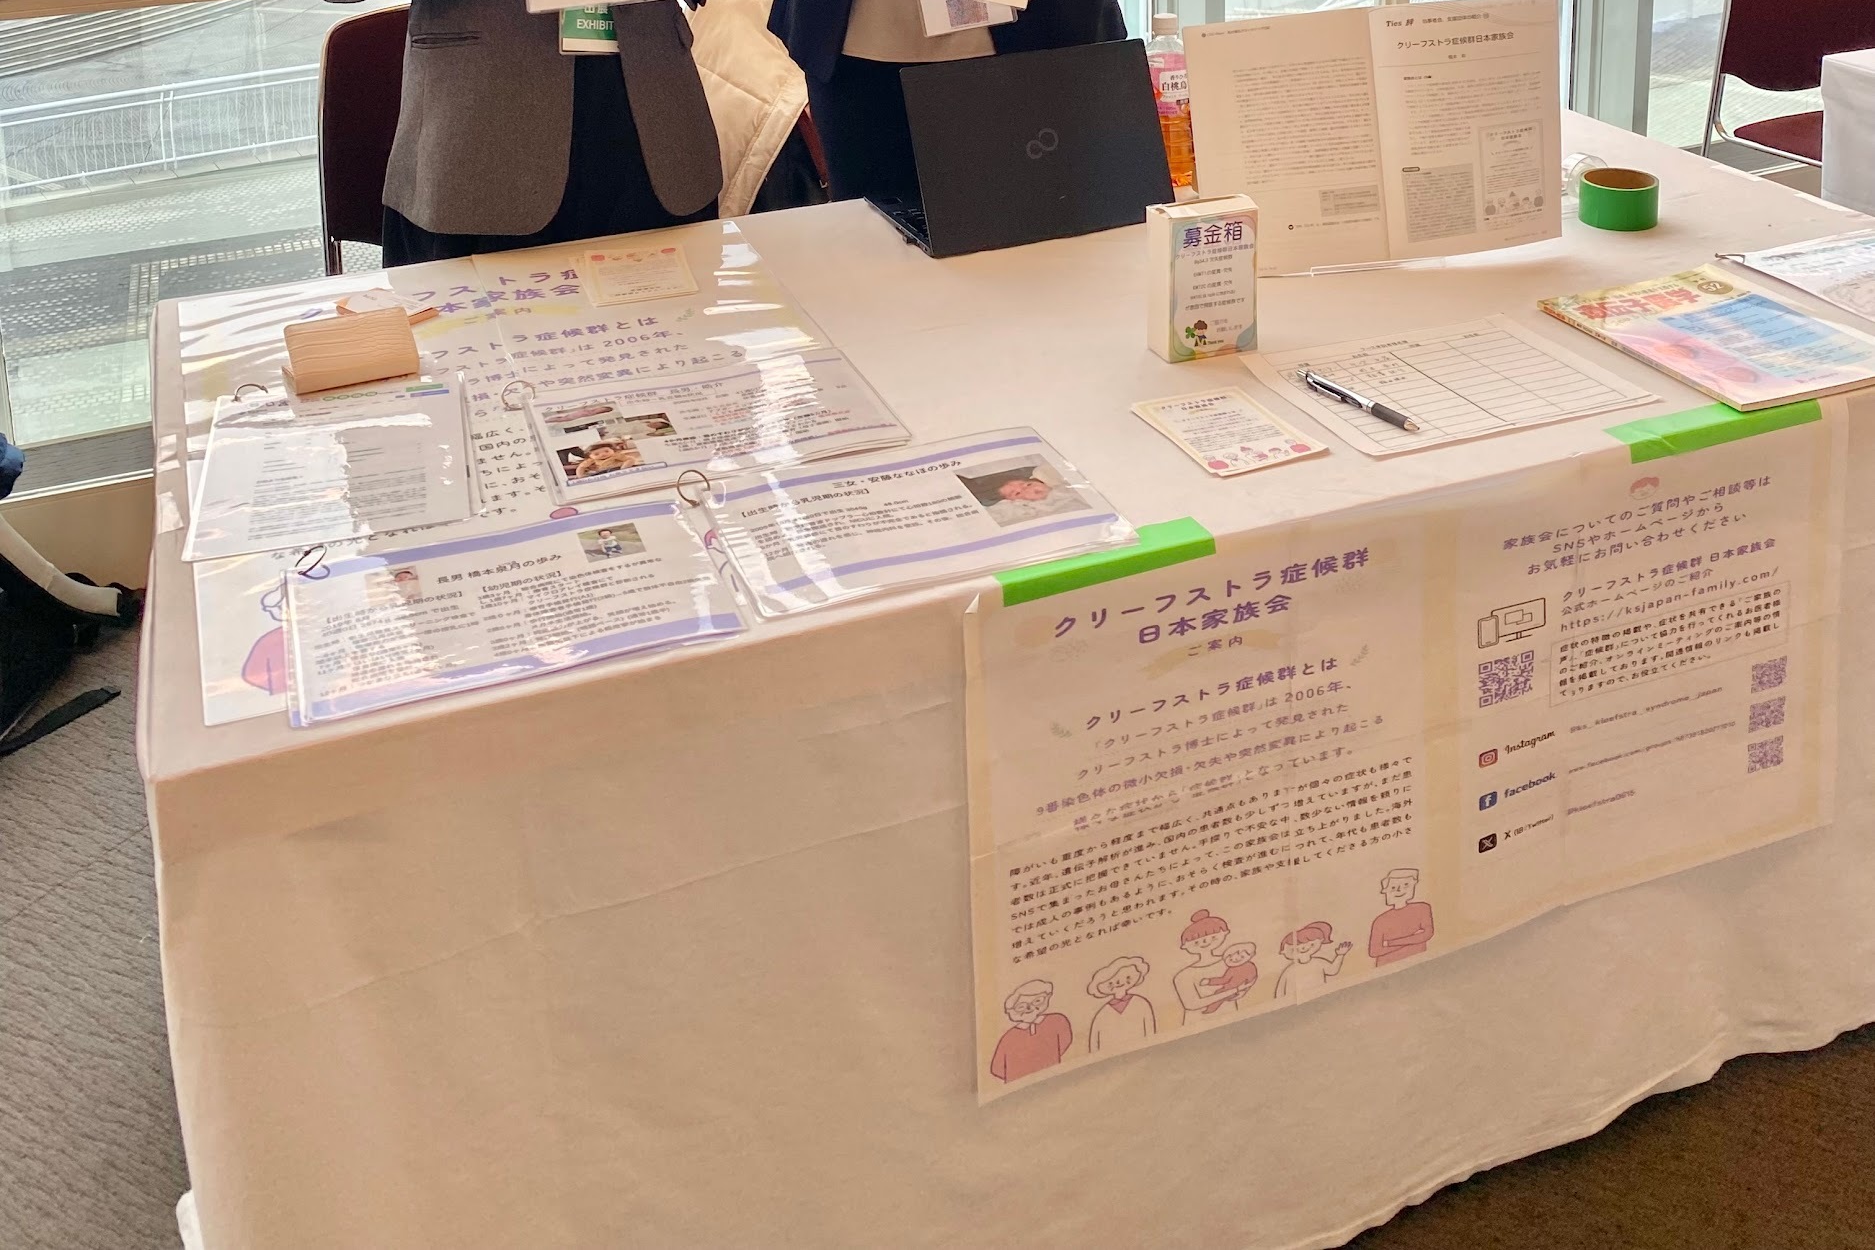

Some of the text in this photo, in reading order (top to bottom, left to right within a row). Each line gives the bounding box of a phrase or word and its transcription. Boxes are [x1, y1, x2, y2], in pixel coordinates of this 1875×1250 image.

[576, 18, 614, 30] EXHIBIT
[1397, 31, 1515, 50] クリーフストラ症候群日本家族会
[1183, 220, 1243, 249] 募金箱
[1703, 281, 1722, 292] 52
[1503, 476, 1771, 551] 家族会についてのご質問やご相談等は
[1552, 502, 1724, 554] SNSやホームページから
[1527, 513, 1748, 575] お気軽にお問い合わせください
[1055, 547, 1369, 638] クリーフストラ症候群
[1561, 568, 1715, 617] 公式ホームページのご紹介
[1562, 537, 1776, 603] クリーフストラ症候群 日本家族会
[1138, 593, 1292, 644] 日本家族会
[1560, 566, 1779, 632] https://ksjapan-family.com/
[1188, 636, 1243, 657] ご案内
[1086, 657, 1338, 731] クリーフストラ症候群とは
[1077, 703, 1349, 780] クリーフストラ博士によって発見された
[1504, 730, 1556, 754] Instagram
[1504, 772, 1557, 798] facebook
